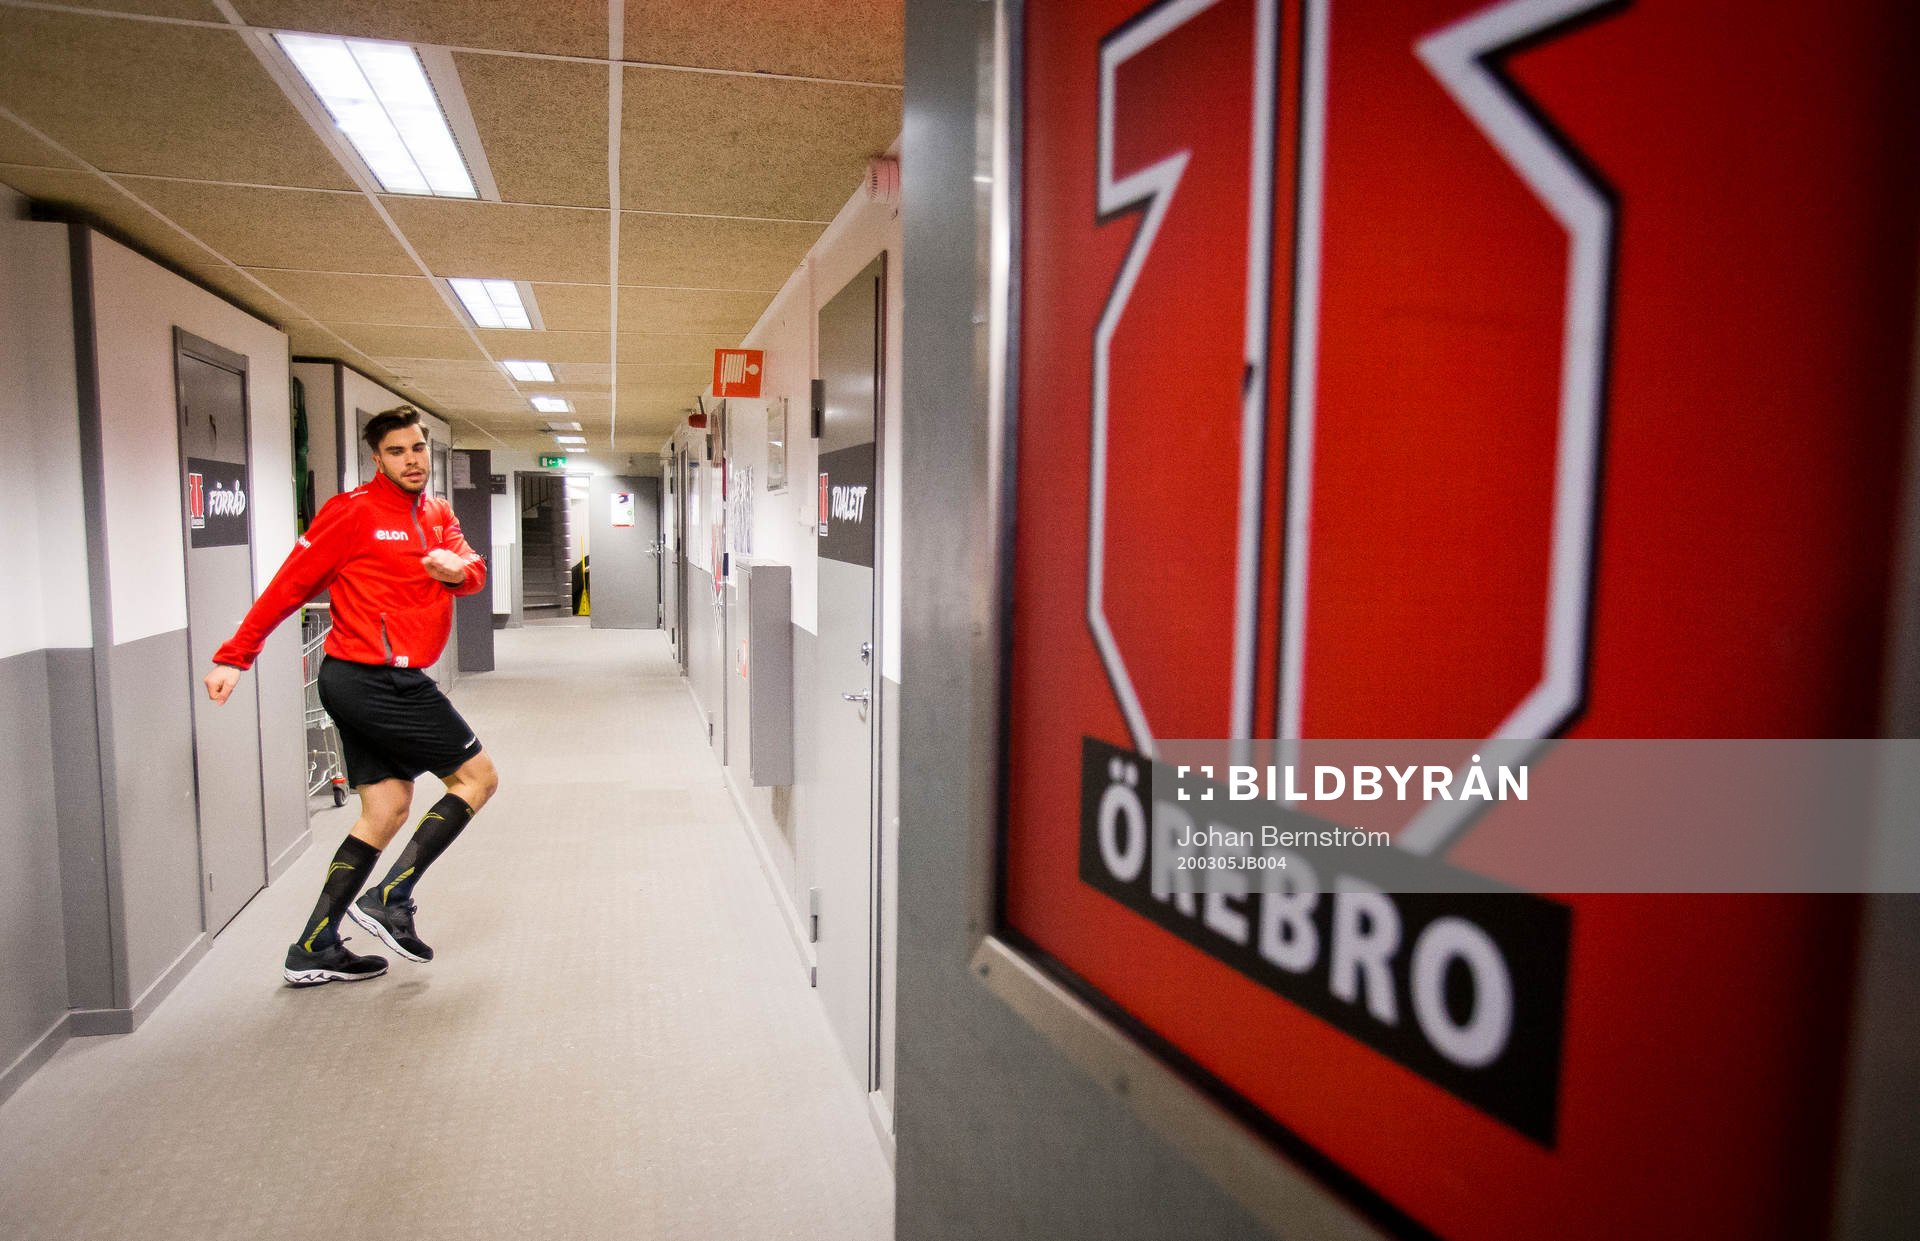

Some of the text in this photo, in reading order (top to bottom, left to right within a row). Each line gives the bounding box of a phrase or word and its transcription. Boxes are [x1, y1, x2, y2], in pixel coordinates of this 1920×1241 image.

[209, 479, 245, 517] FÖRRÅD
[832, 486, 867, 523] TOALETT
[1099, 756, 1515, 1069] ÖREBRO
